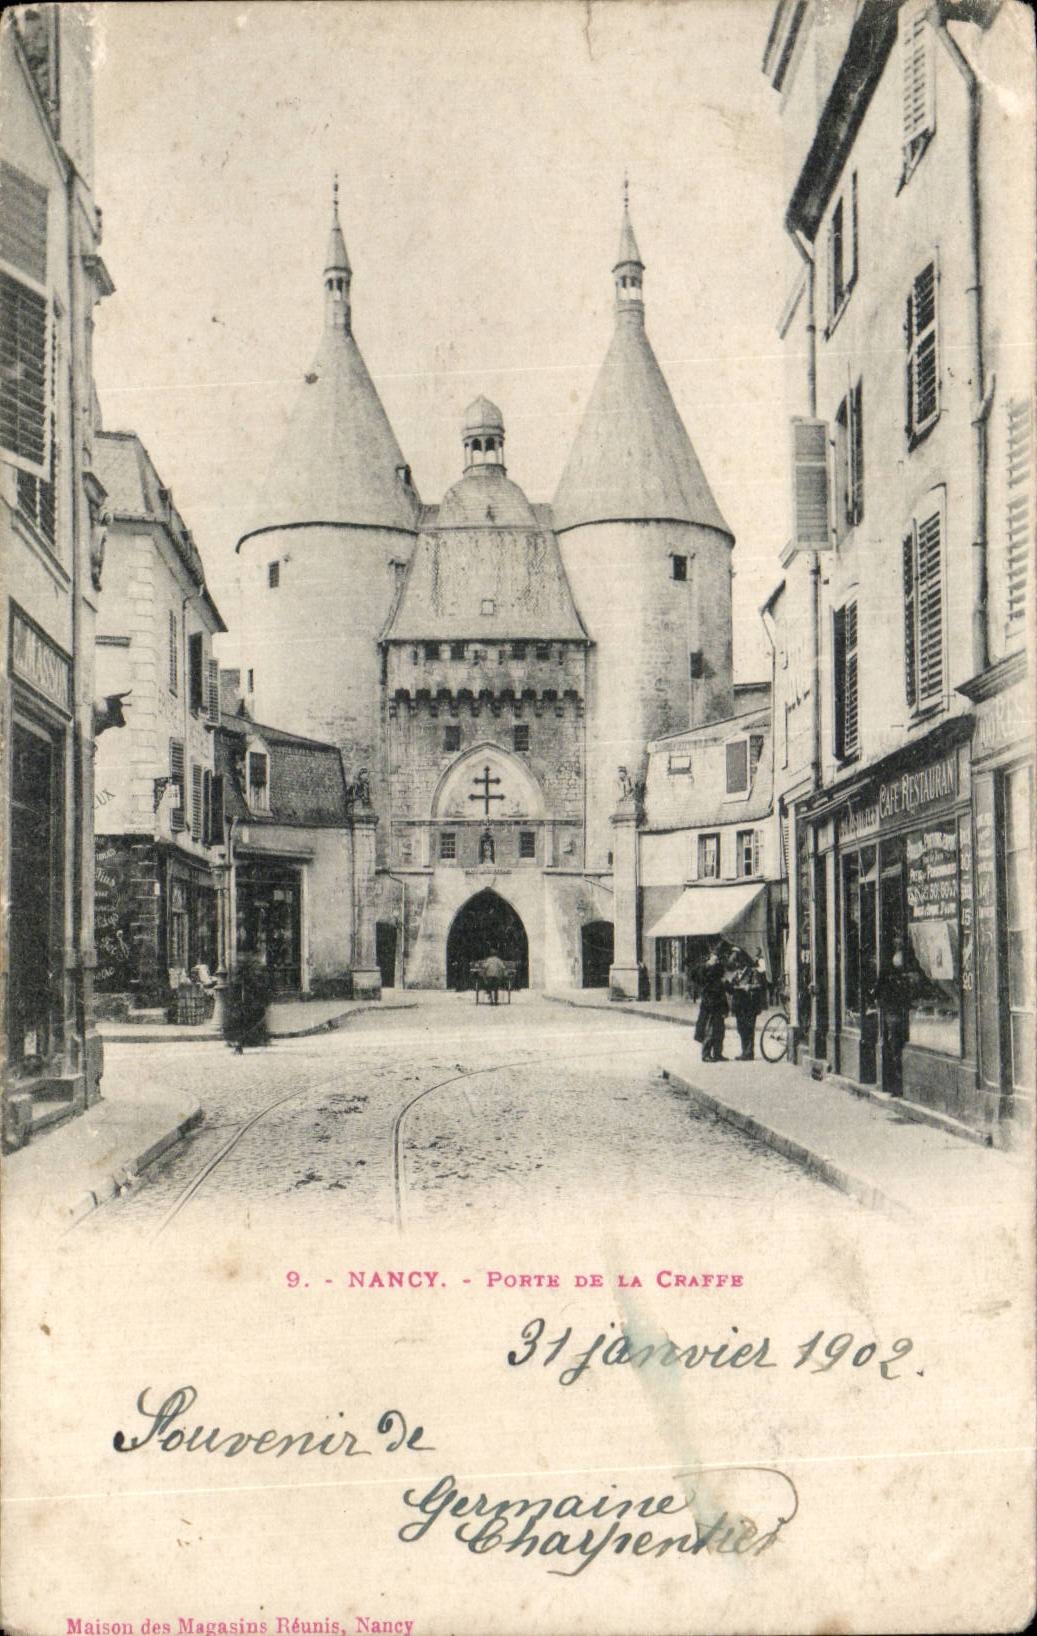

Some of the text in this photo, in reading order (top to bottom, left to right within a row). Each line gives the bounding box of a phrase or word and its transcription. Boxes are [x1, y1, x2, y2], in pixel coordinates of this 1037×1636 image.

[508, 1317, 573, 1367] 31
[558, 1322, 777, 1386] janvier
[112, 1385, 372, 1458] Souvenir
[398, 1474, 694, 1544] Germaine
